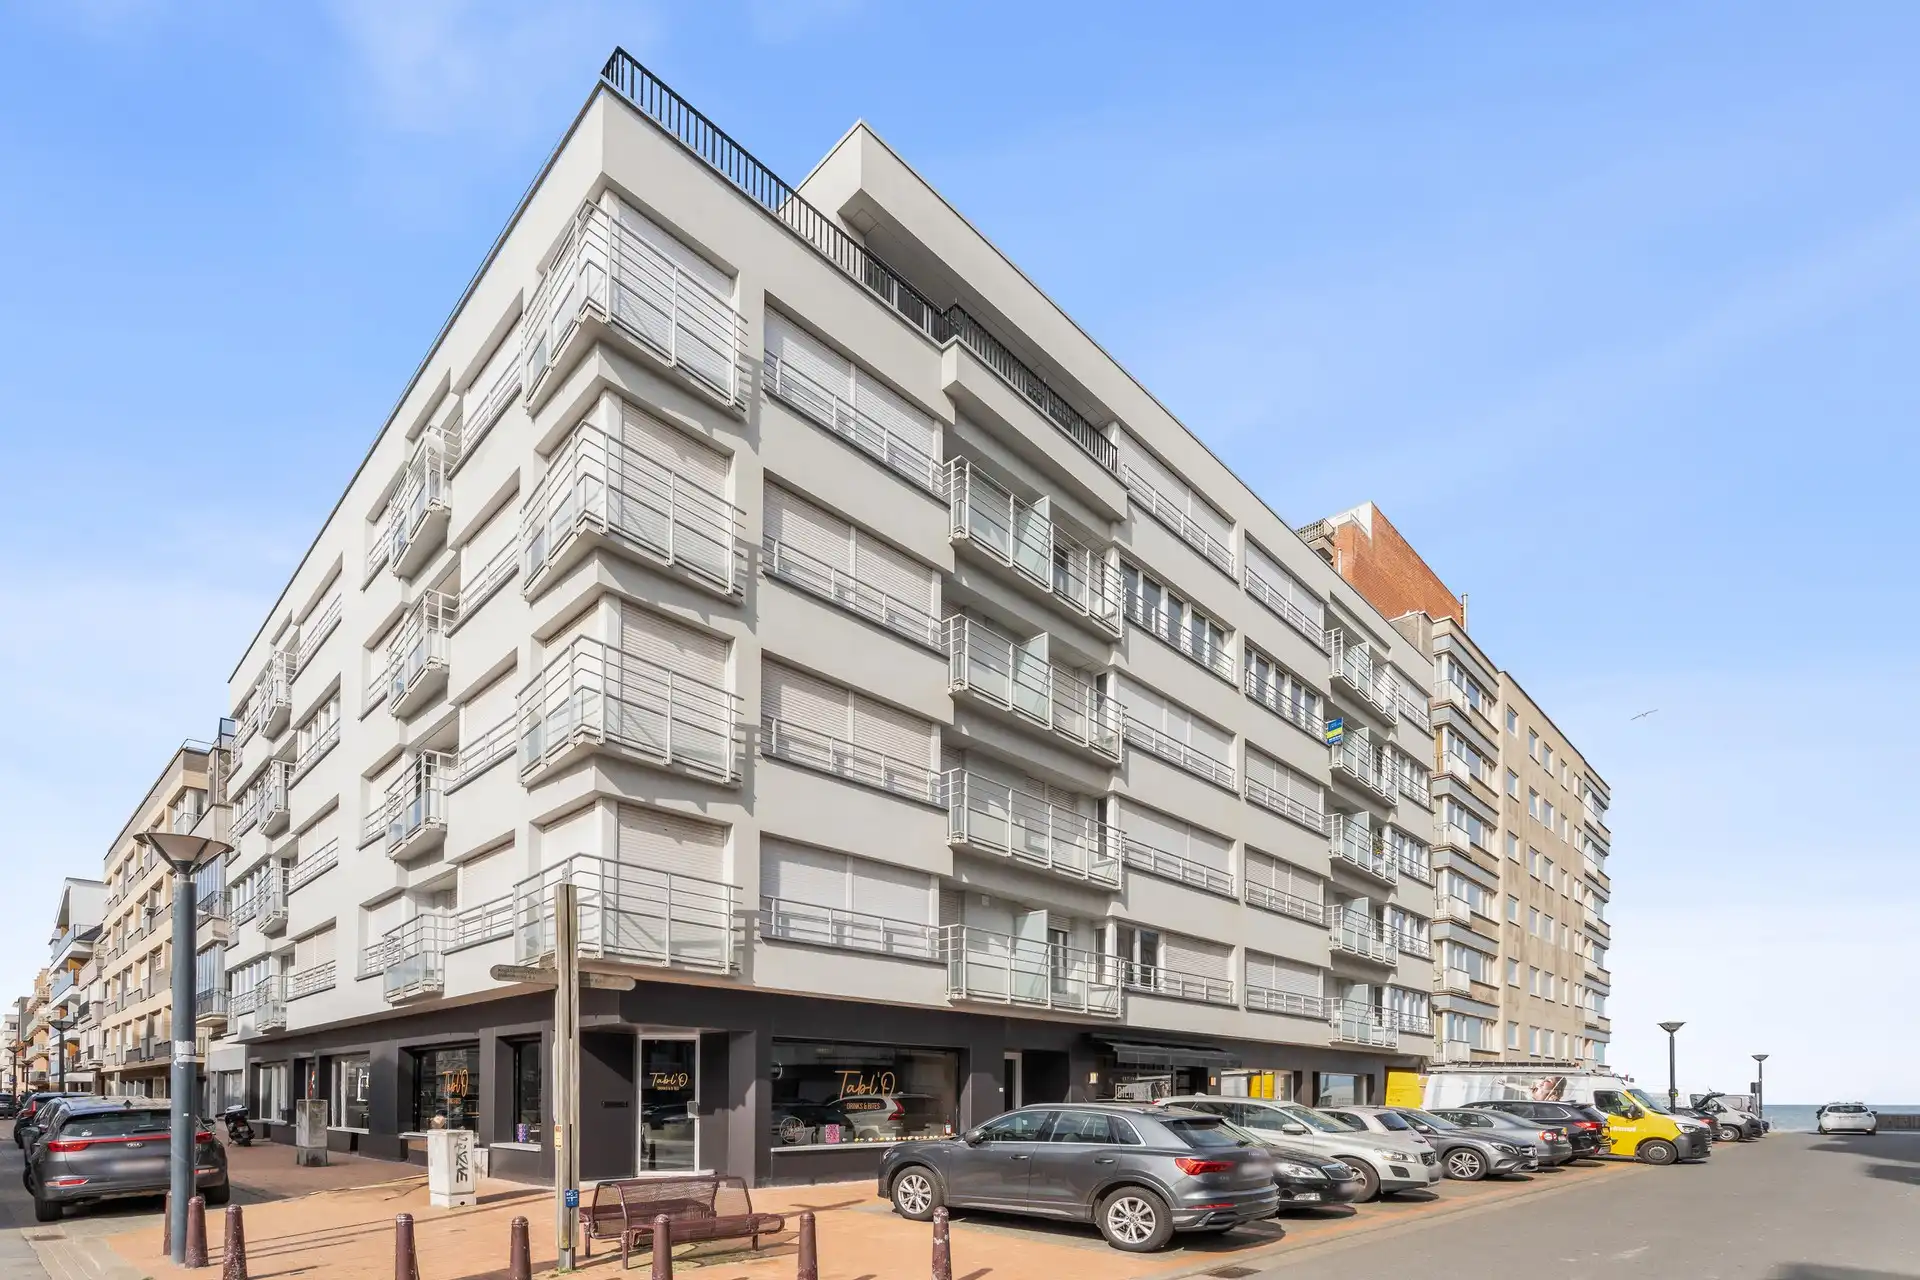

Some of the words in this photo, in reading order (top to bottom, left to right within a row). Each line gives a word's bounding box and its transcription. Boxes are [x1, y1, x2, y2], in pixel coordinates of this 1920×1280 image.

[649, 1072, 688, 1087] Tabl'O
[834, 1070, 896, 1100] Tabl'O
[846, 1102, 863, 1110] DRINKS
